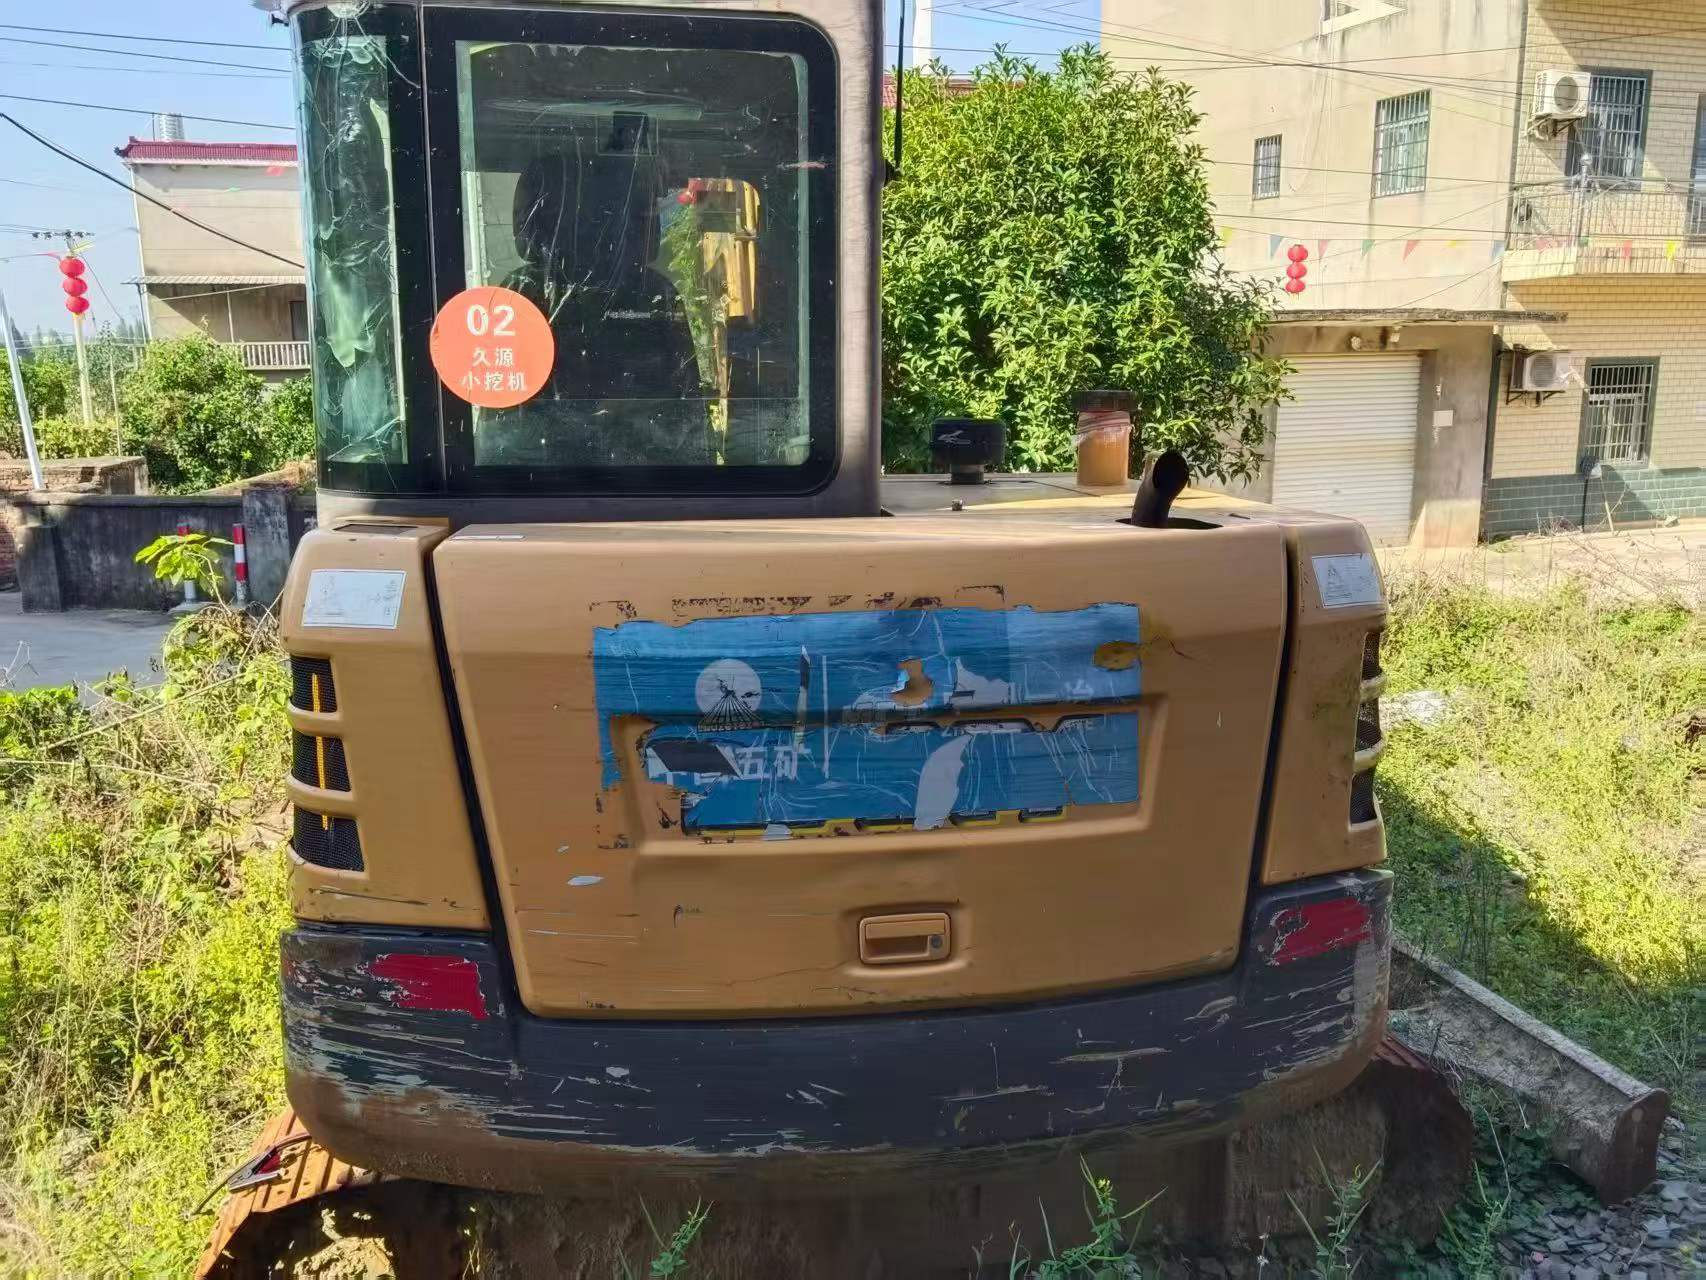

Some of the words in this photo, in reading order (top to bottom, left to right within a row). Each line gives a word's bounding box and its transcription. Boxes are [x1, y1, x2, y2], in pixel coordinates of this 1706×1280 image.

[466, 304, 516, 337] 02
[472, 347, 513, 368] 久源
[460, 371, 527, 392] 小挖机
